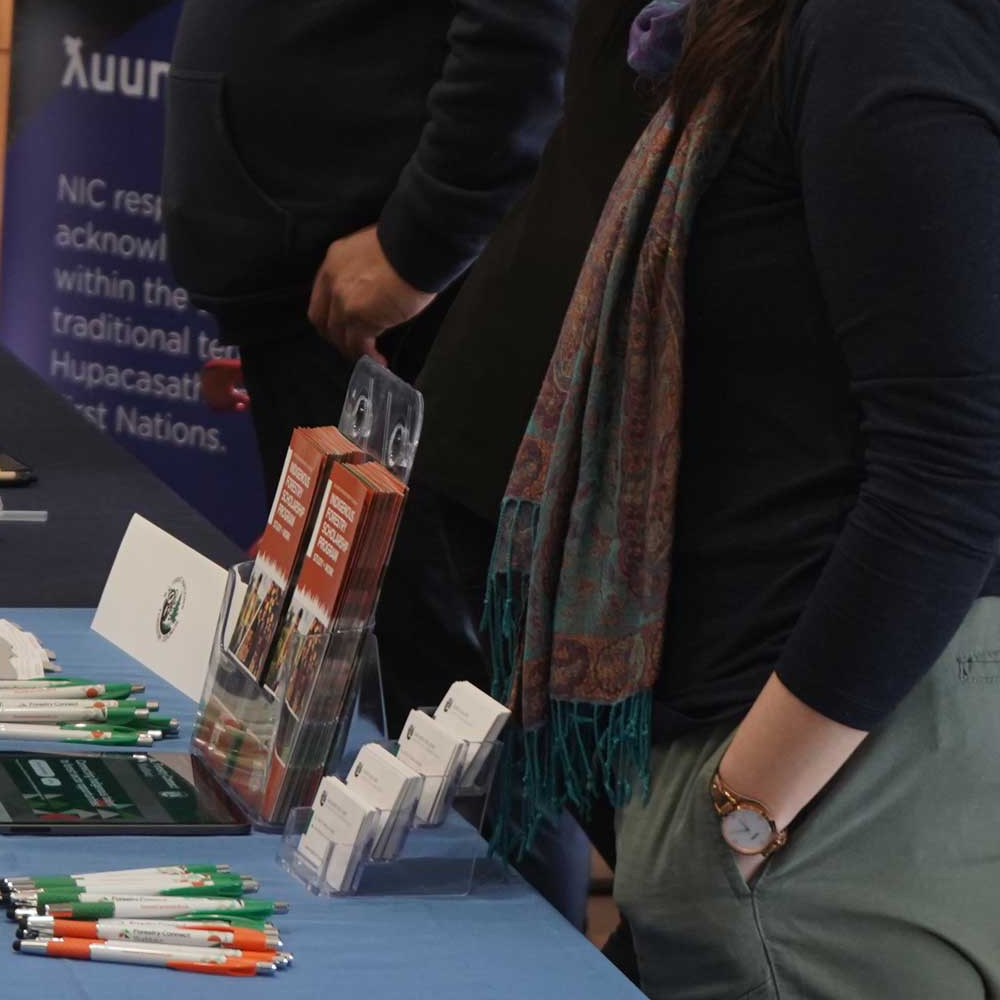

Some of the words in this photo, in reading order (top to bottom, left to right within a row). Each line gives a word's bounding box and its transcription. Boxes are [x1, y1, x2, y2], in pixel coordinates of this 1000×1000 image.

[57, 172, 107, 209] NIC
[54, 264, 135, 301] within
[144, 276, 188, 310] the
[53, 306, 190, 355] traditional
[115, 405, 227, 453] Nations.
[326, 507, 348, 533] FORESTRY
[329, 492, 356, 523] INDIGENOUS
[317, 535, 340, 562] PROGRAM
[321, 521, 349, 552] SCHOLARSHIP
[133, 929, 160, 937] Forestry
[162, 931, 191, 939] Connect
